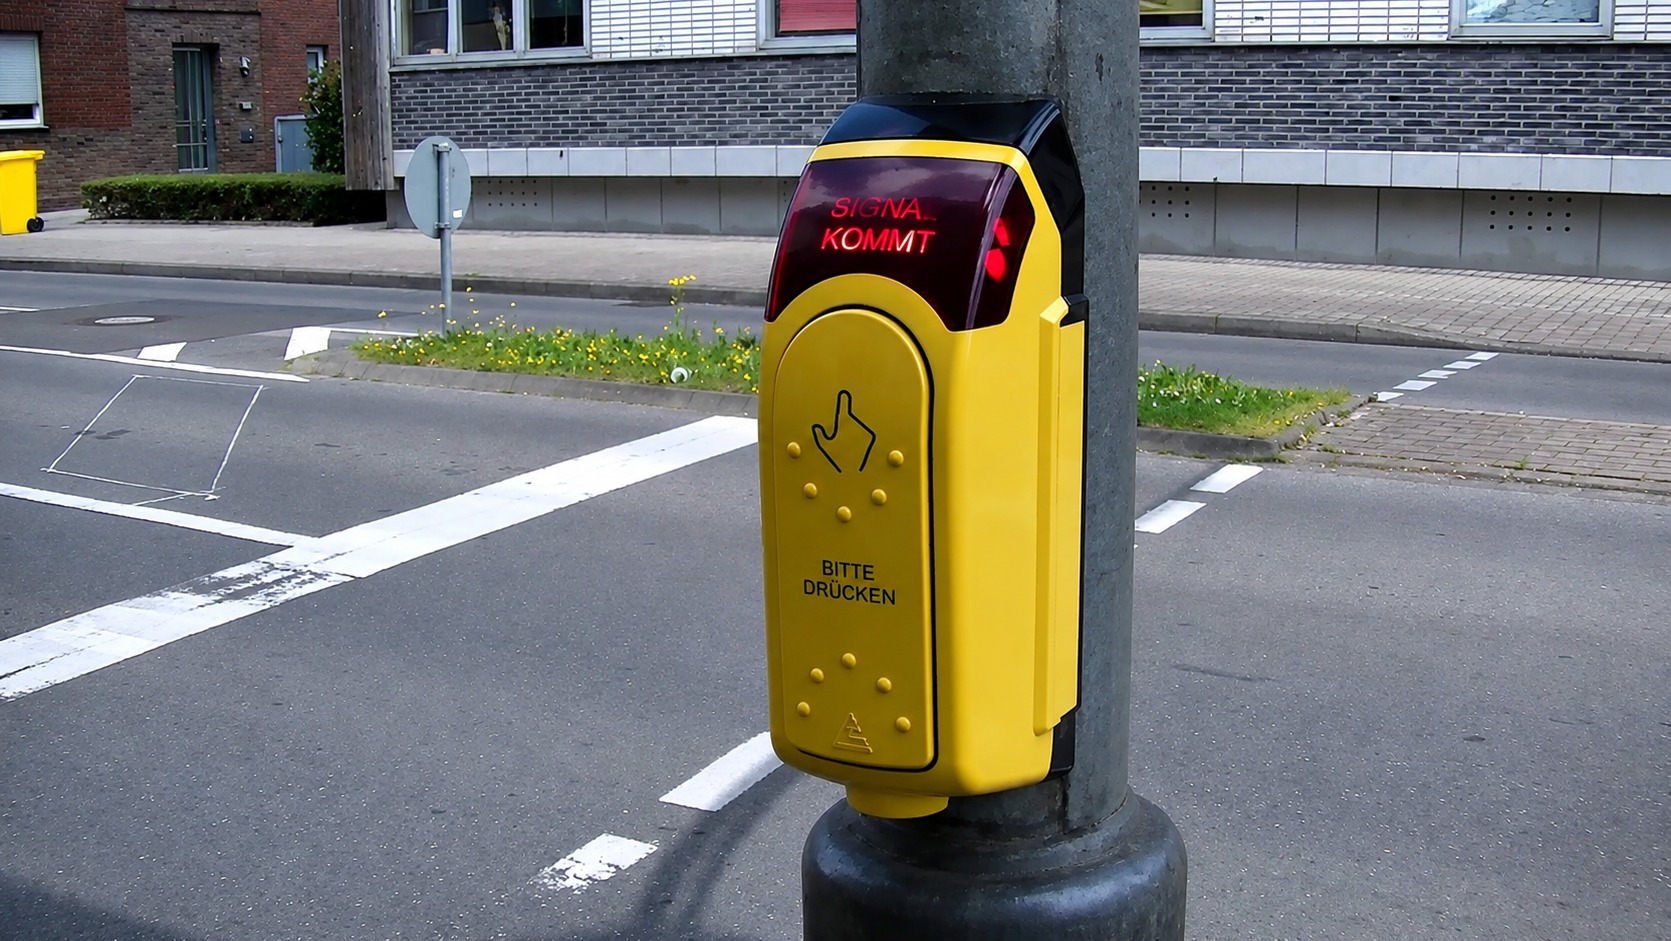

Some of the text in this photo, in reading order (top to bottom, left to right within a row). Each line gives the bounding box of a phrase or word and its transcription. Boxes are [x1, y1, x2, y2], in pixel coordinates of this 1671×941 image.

[821, 227, 936, 254] KOMMT
[822, 559, 875, 581] BITTE
[803, 579, 896, 605] DRÜCKEN
